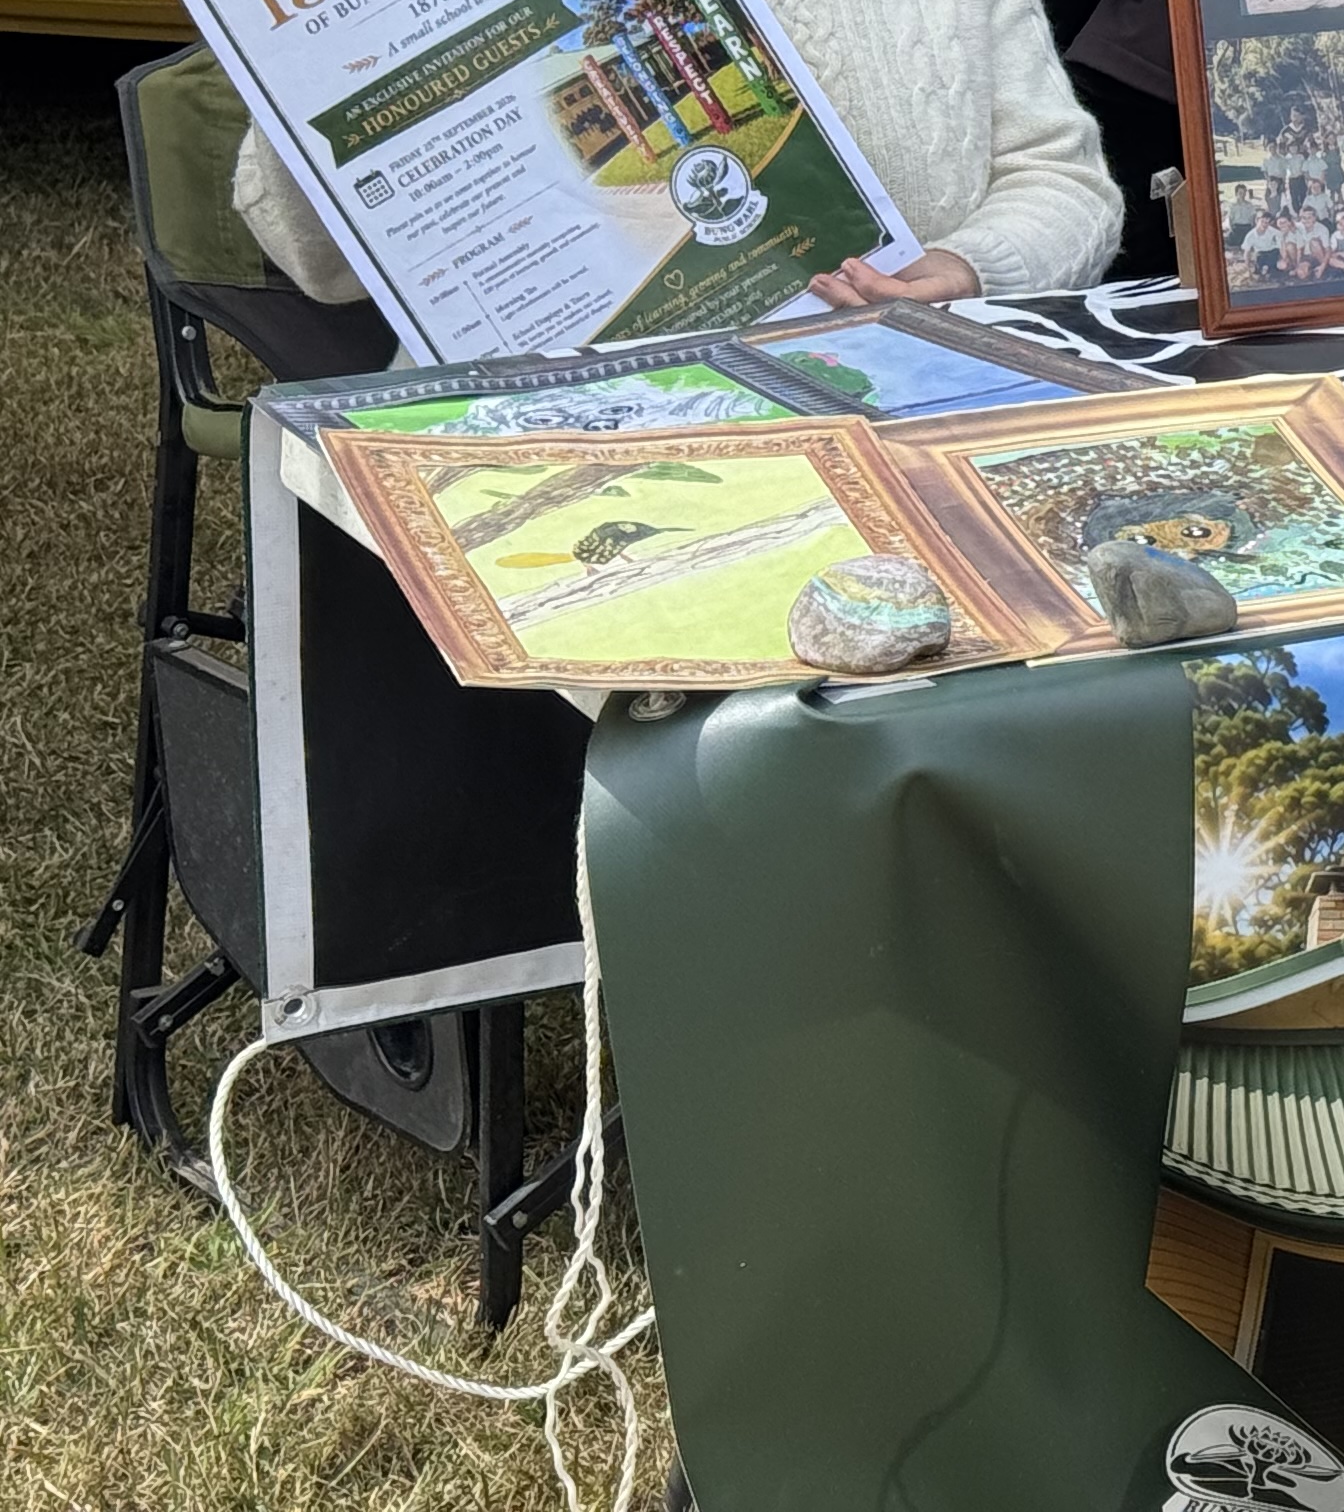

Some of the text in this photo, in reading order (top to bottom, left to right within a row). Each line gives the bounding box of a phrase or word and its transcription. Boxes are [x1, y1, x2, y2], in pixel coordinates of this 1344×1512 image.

[305, 10, 329, 34] OF
[388, 41, 399, 57] A
[399, 19, 433, 48] small
[652, 15, 712, 104] RESPECT
[345, 6, 533, 121] AN EXCLUSIVE INVITATION FOR OUR
[361, 21, 541, 135] HONOURED GUESTS
[397, 106, 522, 187] CELEBRATION DAY
[451, 232, 505, 269] PROGRAM
